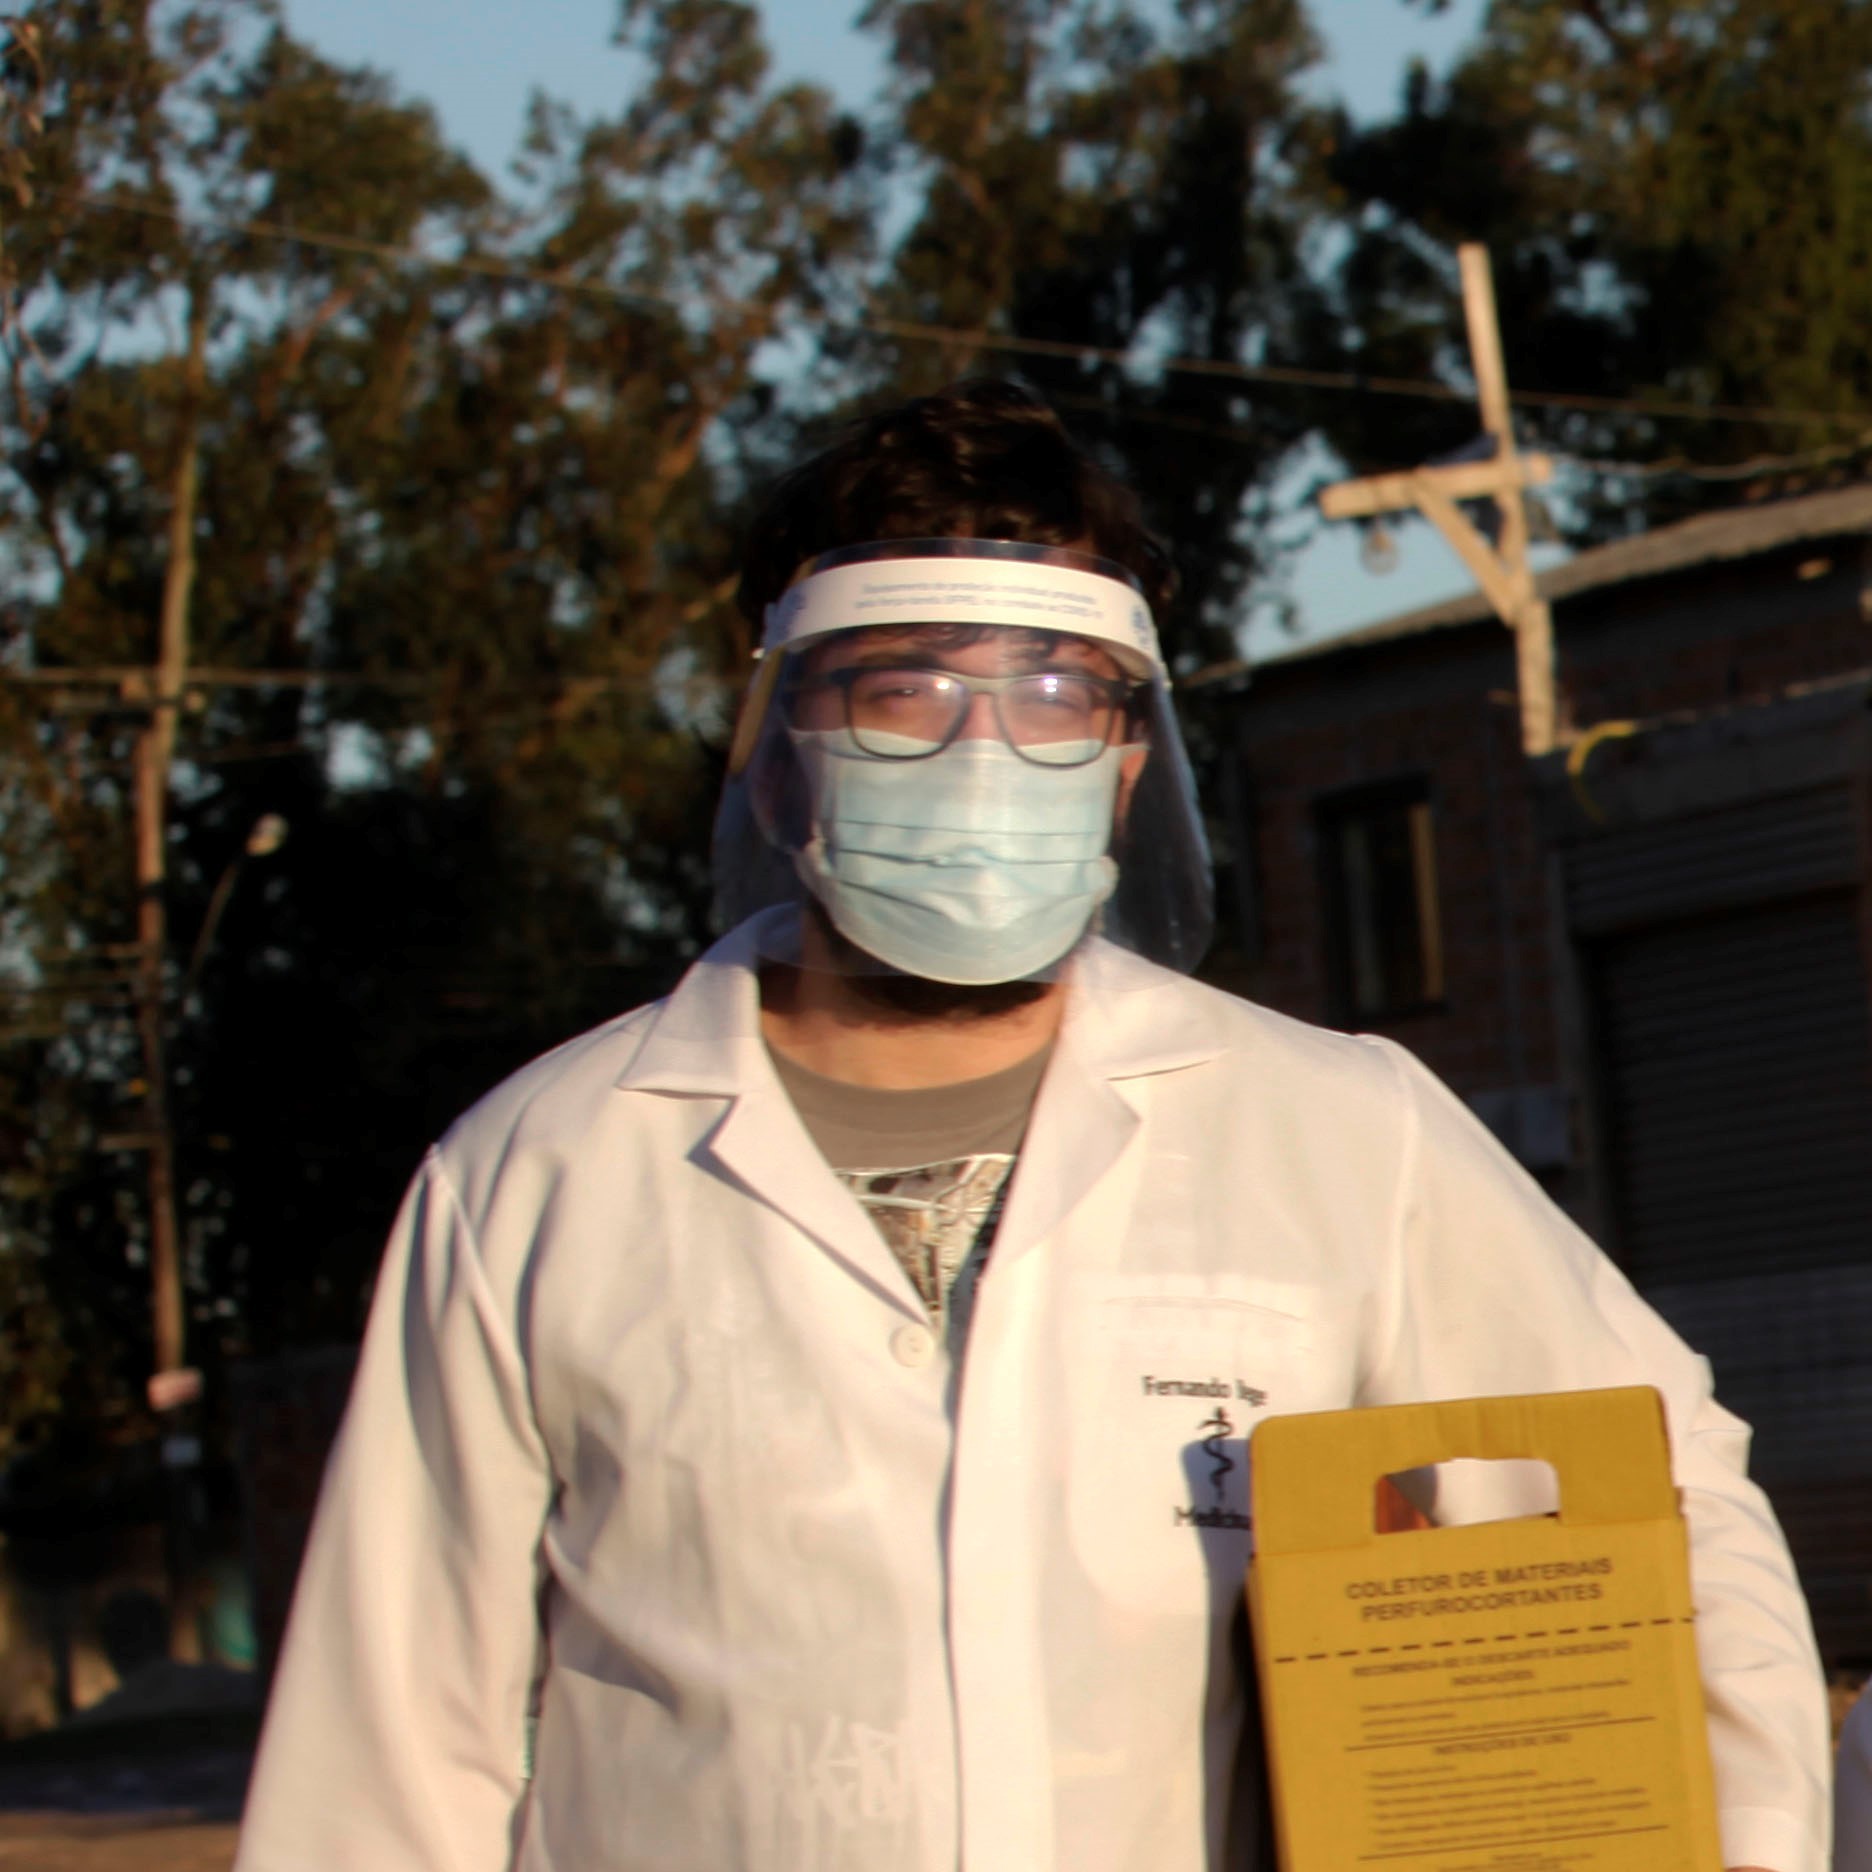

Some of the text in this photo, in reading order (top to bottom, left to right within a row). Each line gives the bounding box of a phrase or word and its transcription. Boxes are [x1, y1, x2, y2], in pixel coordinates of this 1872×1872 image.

[1142, 1375, 1232, 1400] Fernando
[1174, 1505, 1251, 1531] Medicin
[1346, 1557, 1613, 1600] COLETOR DE MATERIAIS
[1361, 1582, 1603, 1622] PERFUROCORTANTES
